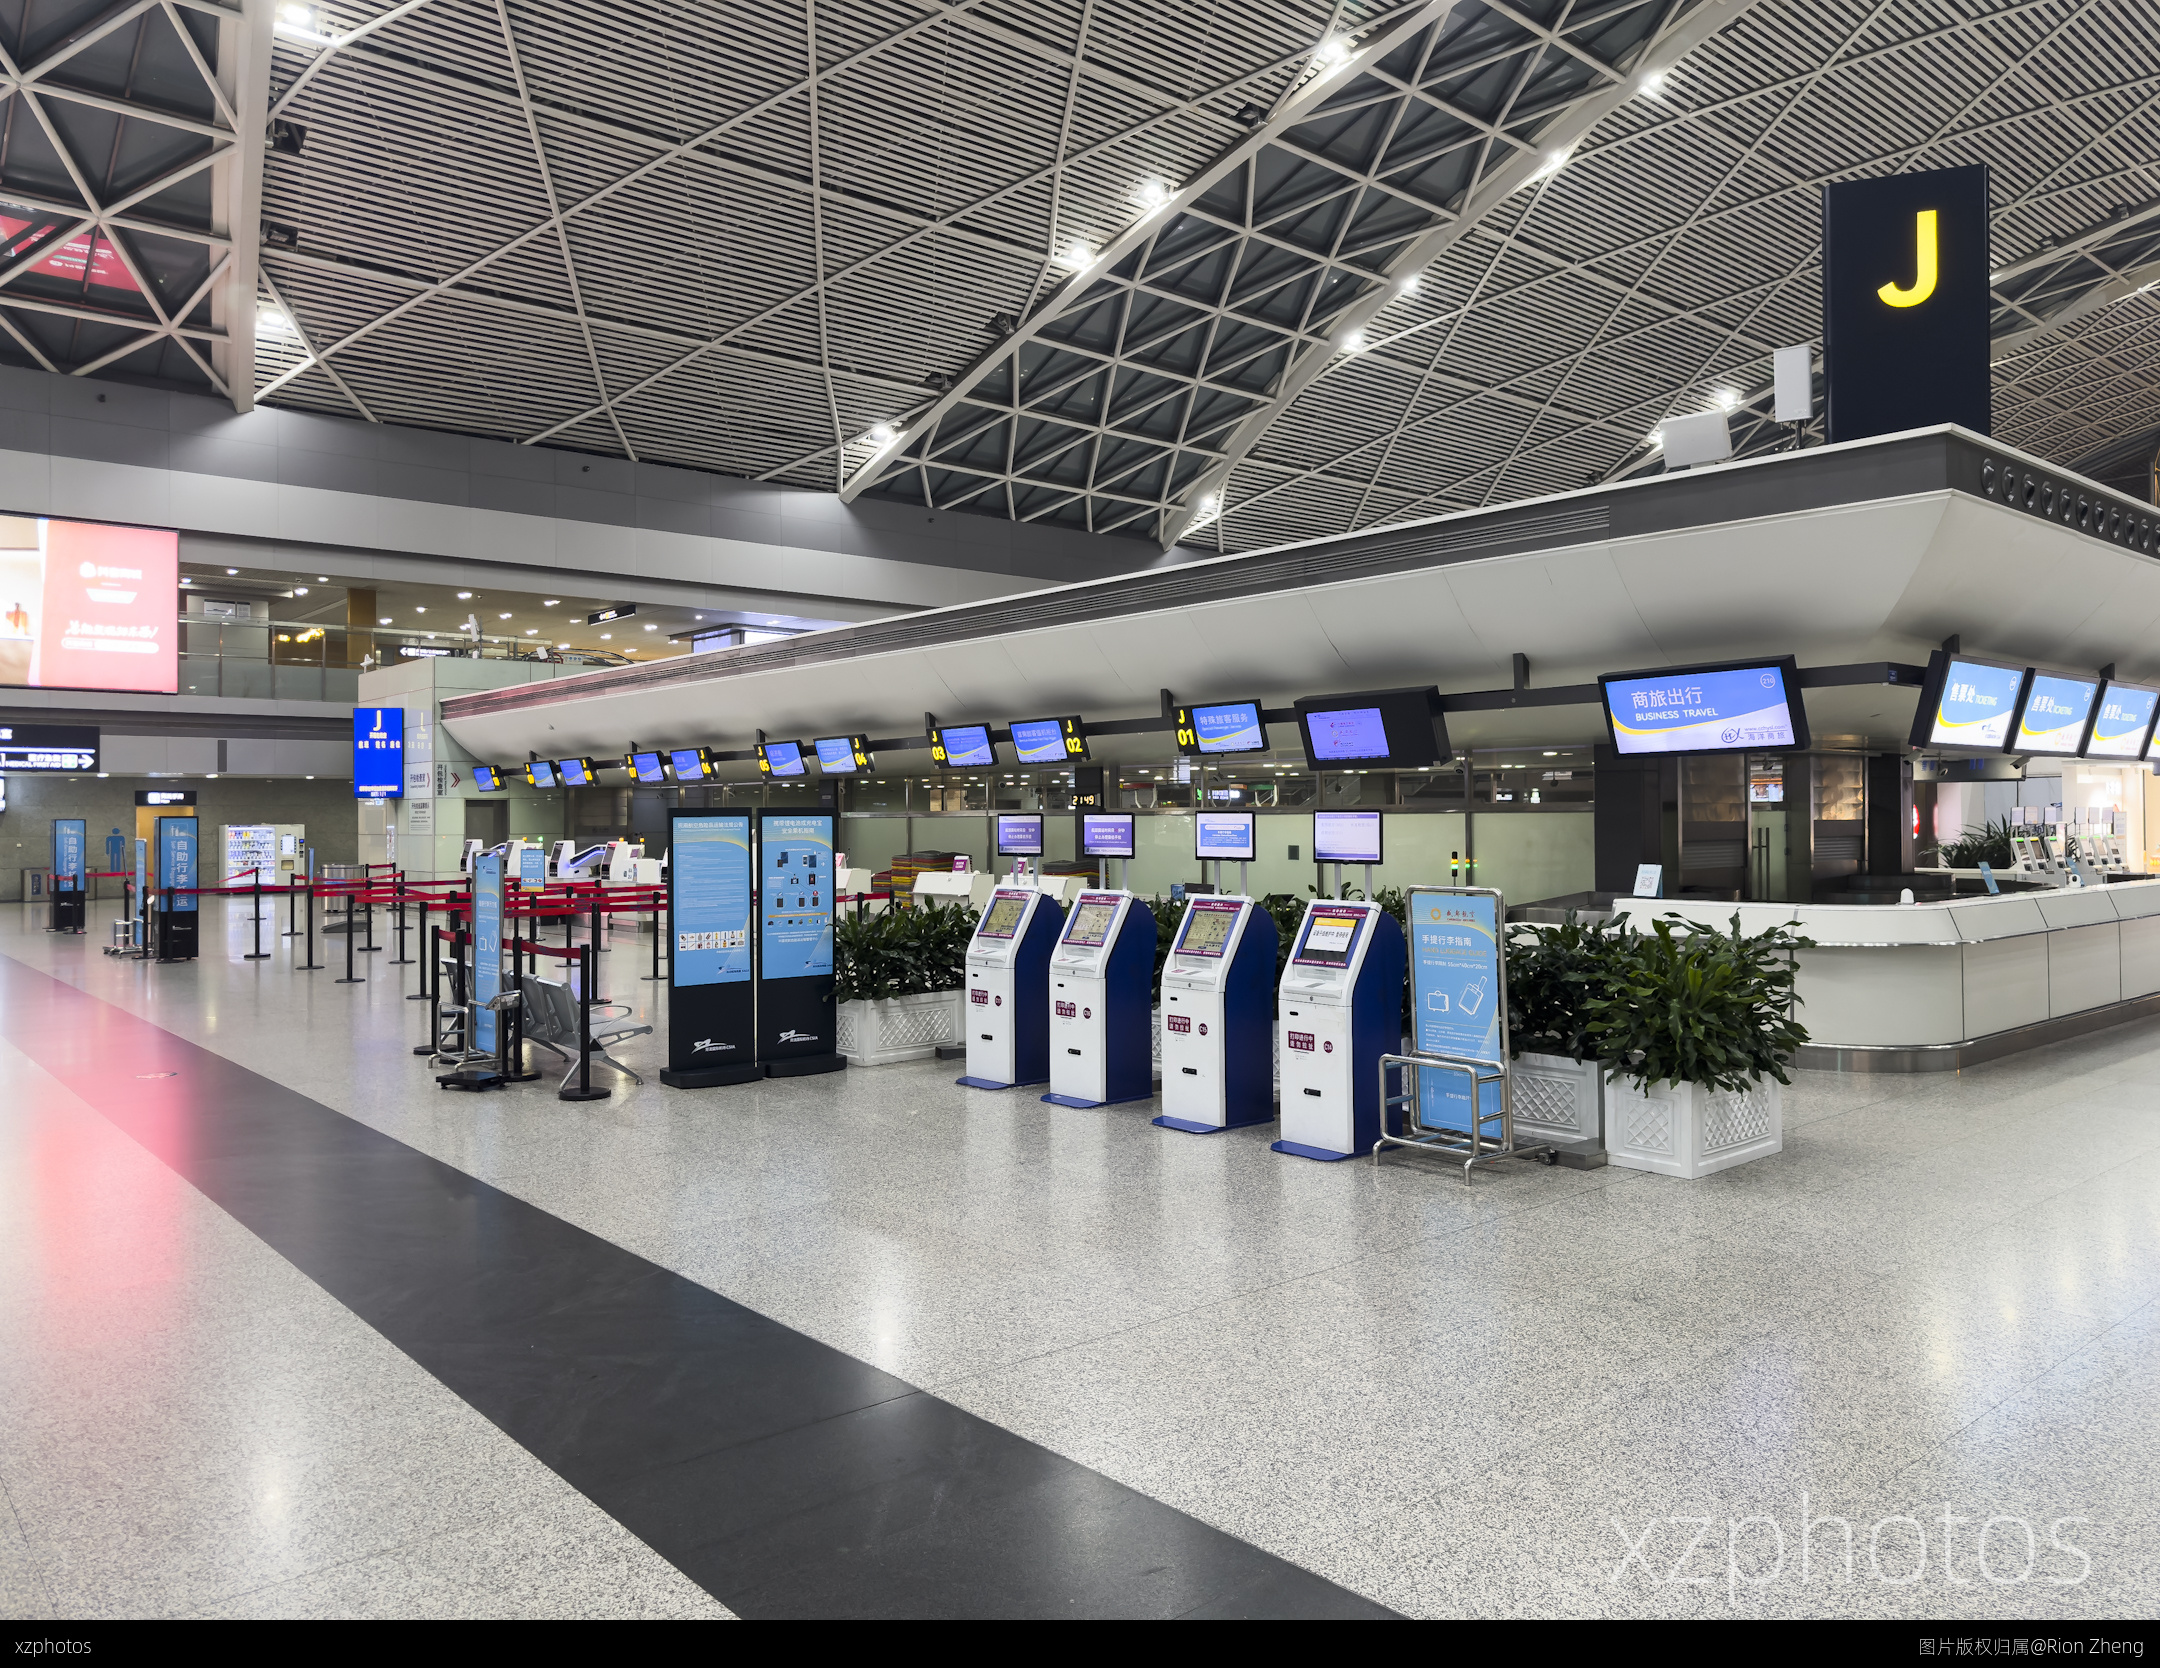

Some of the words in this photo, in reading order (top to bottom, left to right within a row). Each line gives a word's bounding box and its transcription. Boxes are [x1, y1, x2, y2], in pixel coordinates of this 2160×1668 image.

[1877, 209, 1938, 308] J
[1631, 686, 1703, 709] 商旅出行
[1949, 682, 1976, 704] 售票处
[1975, 694, 1998, 706] TICKETING
[2031, 695, 2055, 714] 售票处
[1178, 709, 1186, 724] J
[1635, 710, 1679, 722] BUSINESS
[1683, 707, 1718, 718] TRAVEL
[2103, 704, 2121, 720] 售票处
[372, 710, 382, 732] J
[1200, 713, 1248, 725] 特殊旅客服务
[1066, 719, 1073, 733] J
[932, 730, 938, 742] J
[1178, 728, 1195, 746] 01
[854, 738, 860, 749] J
[1066, 737, 1083, 753] 02
[700, 749, 705, 760] J
[758, 746, 763, 756] J
[932, 746, 946, 760] 03
[582, 759, 587, 768] J
[627, 756, 632, 764] J
[854, 752, 868, 766] 04
[759, 760, 770, 772] 05
[1422, 934, 1472, 947] 手提行李指南
[1440, 948, 1467, 956] LUGGAGE
[1290, 1033, 1314, 1042] 打印进行中
[1290, 1040, 1313, 1050] 请勿拉扯
